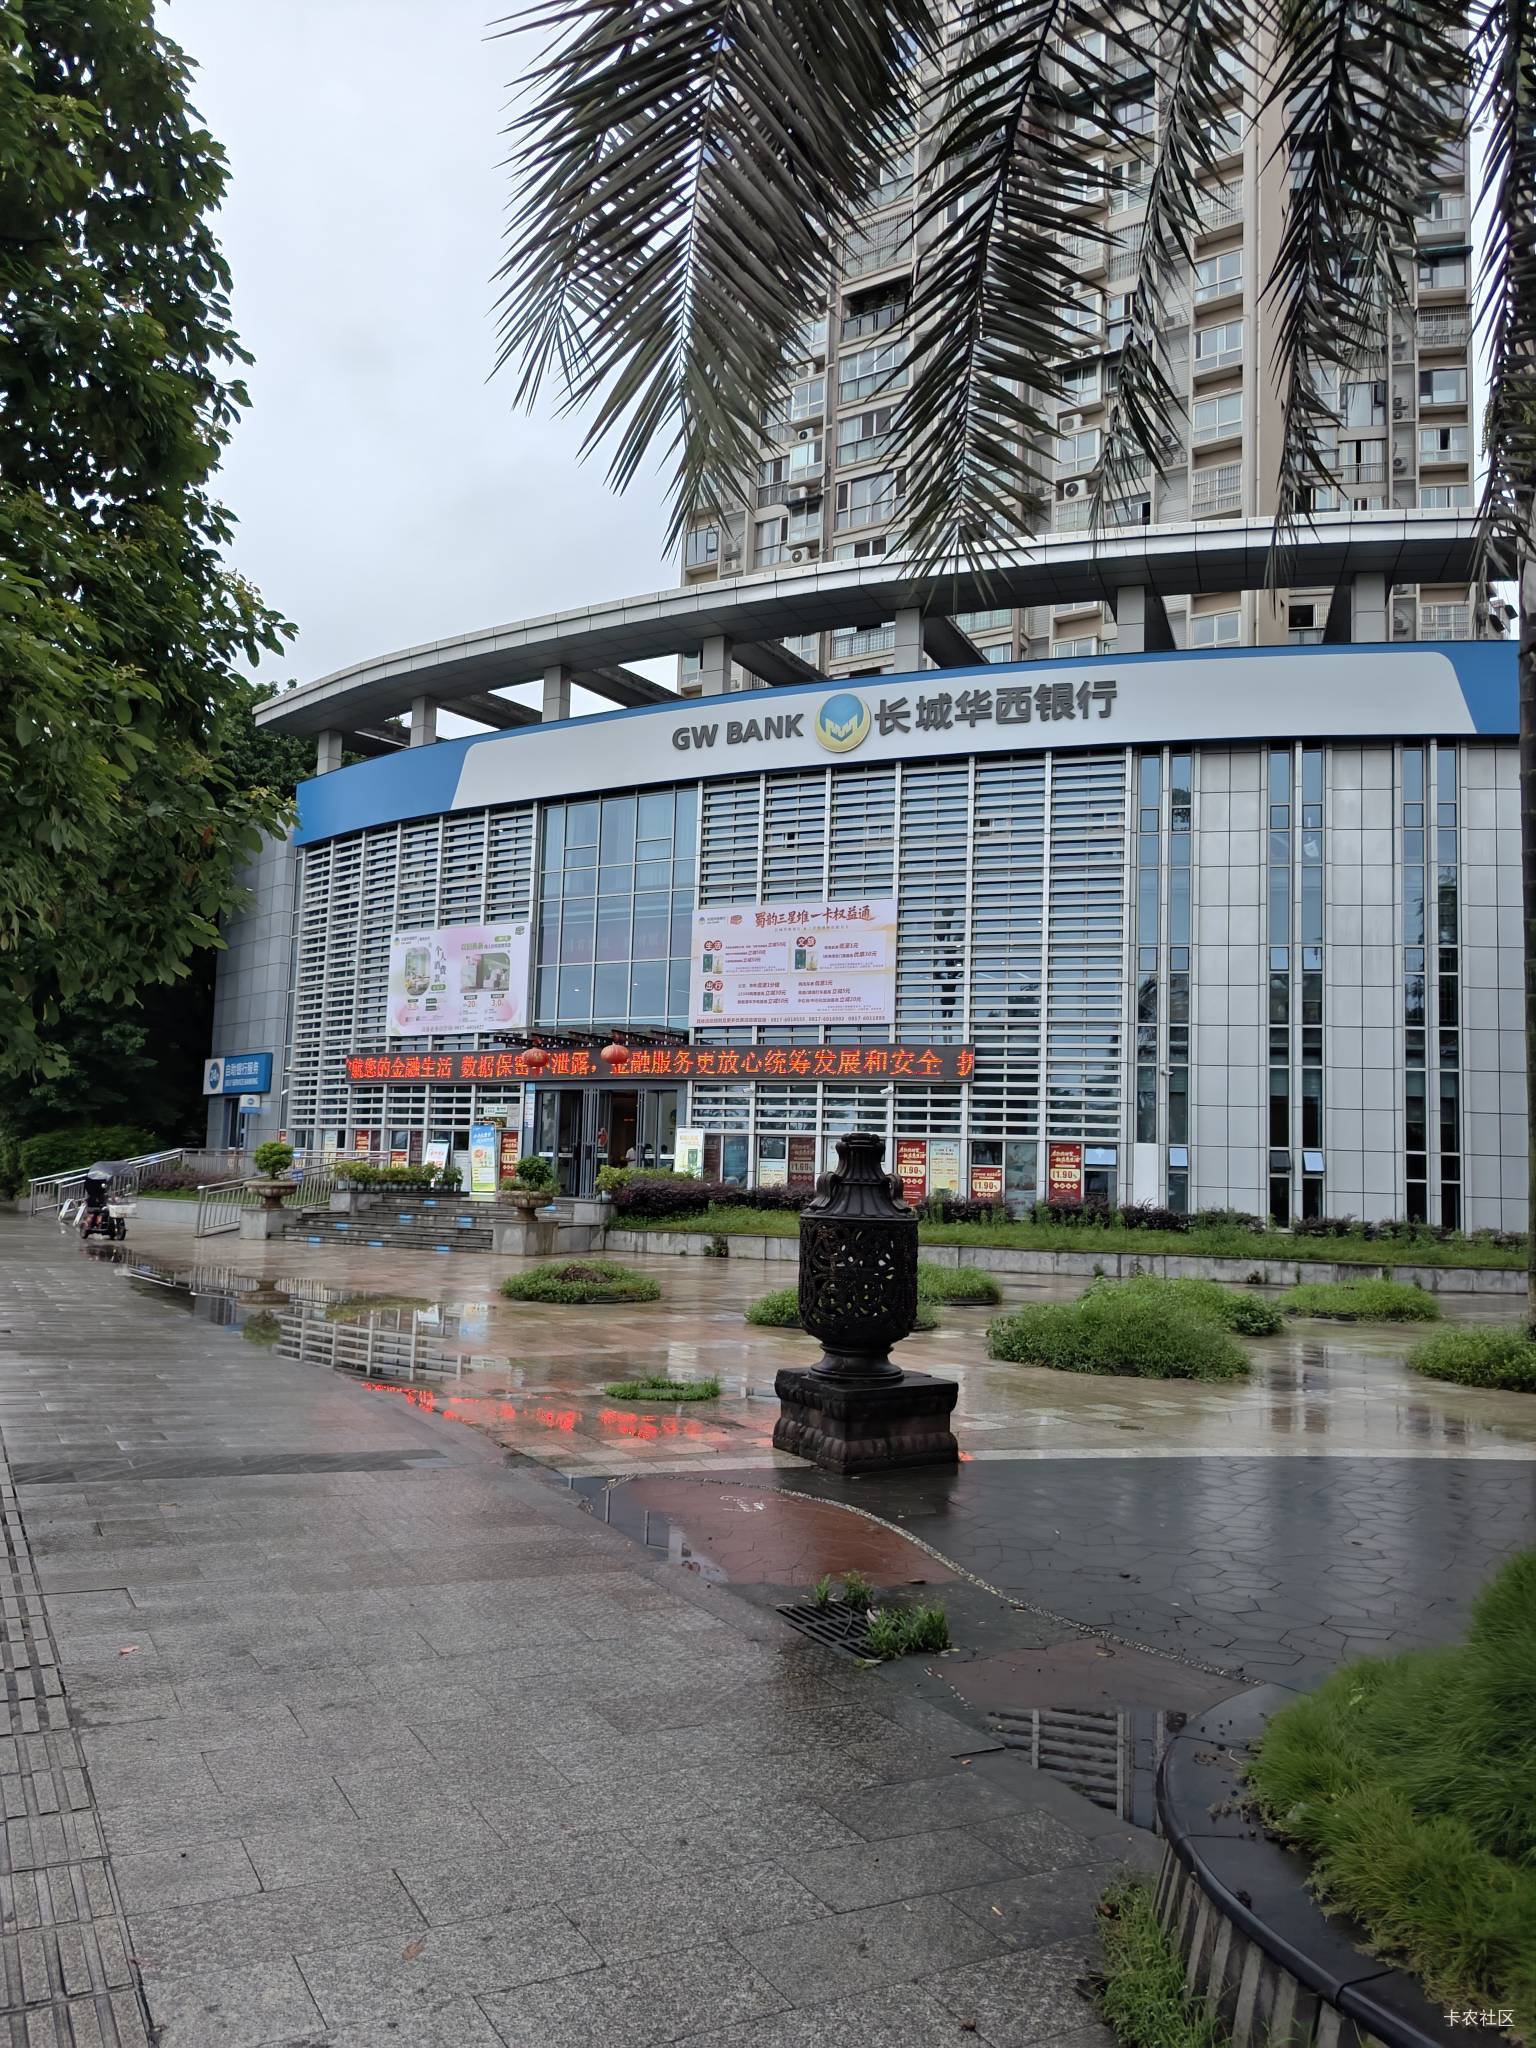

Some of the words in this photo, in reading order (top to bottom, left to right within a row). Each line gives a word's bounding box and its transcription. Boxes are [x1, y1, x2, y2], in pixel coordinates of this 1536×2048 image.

[874, 679, 1118, 737] 长城华西银行
[672, 723, 718, 751] GW
[726, 713, 804, 745] BANK
[755, 904, 876, 929] 蜀韵三星堆一卡权益通
[346, 1055, 453, 1079] 航您的金融生活
